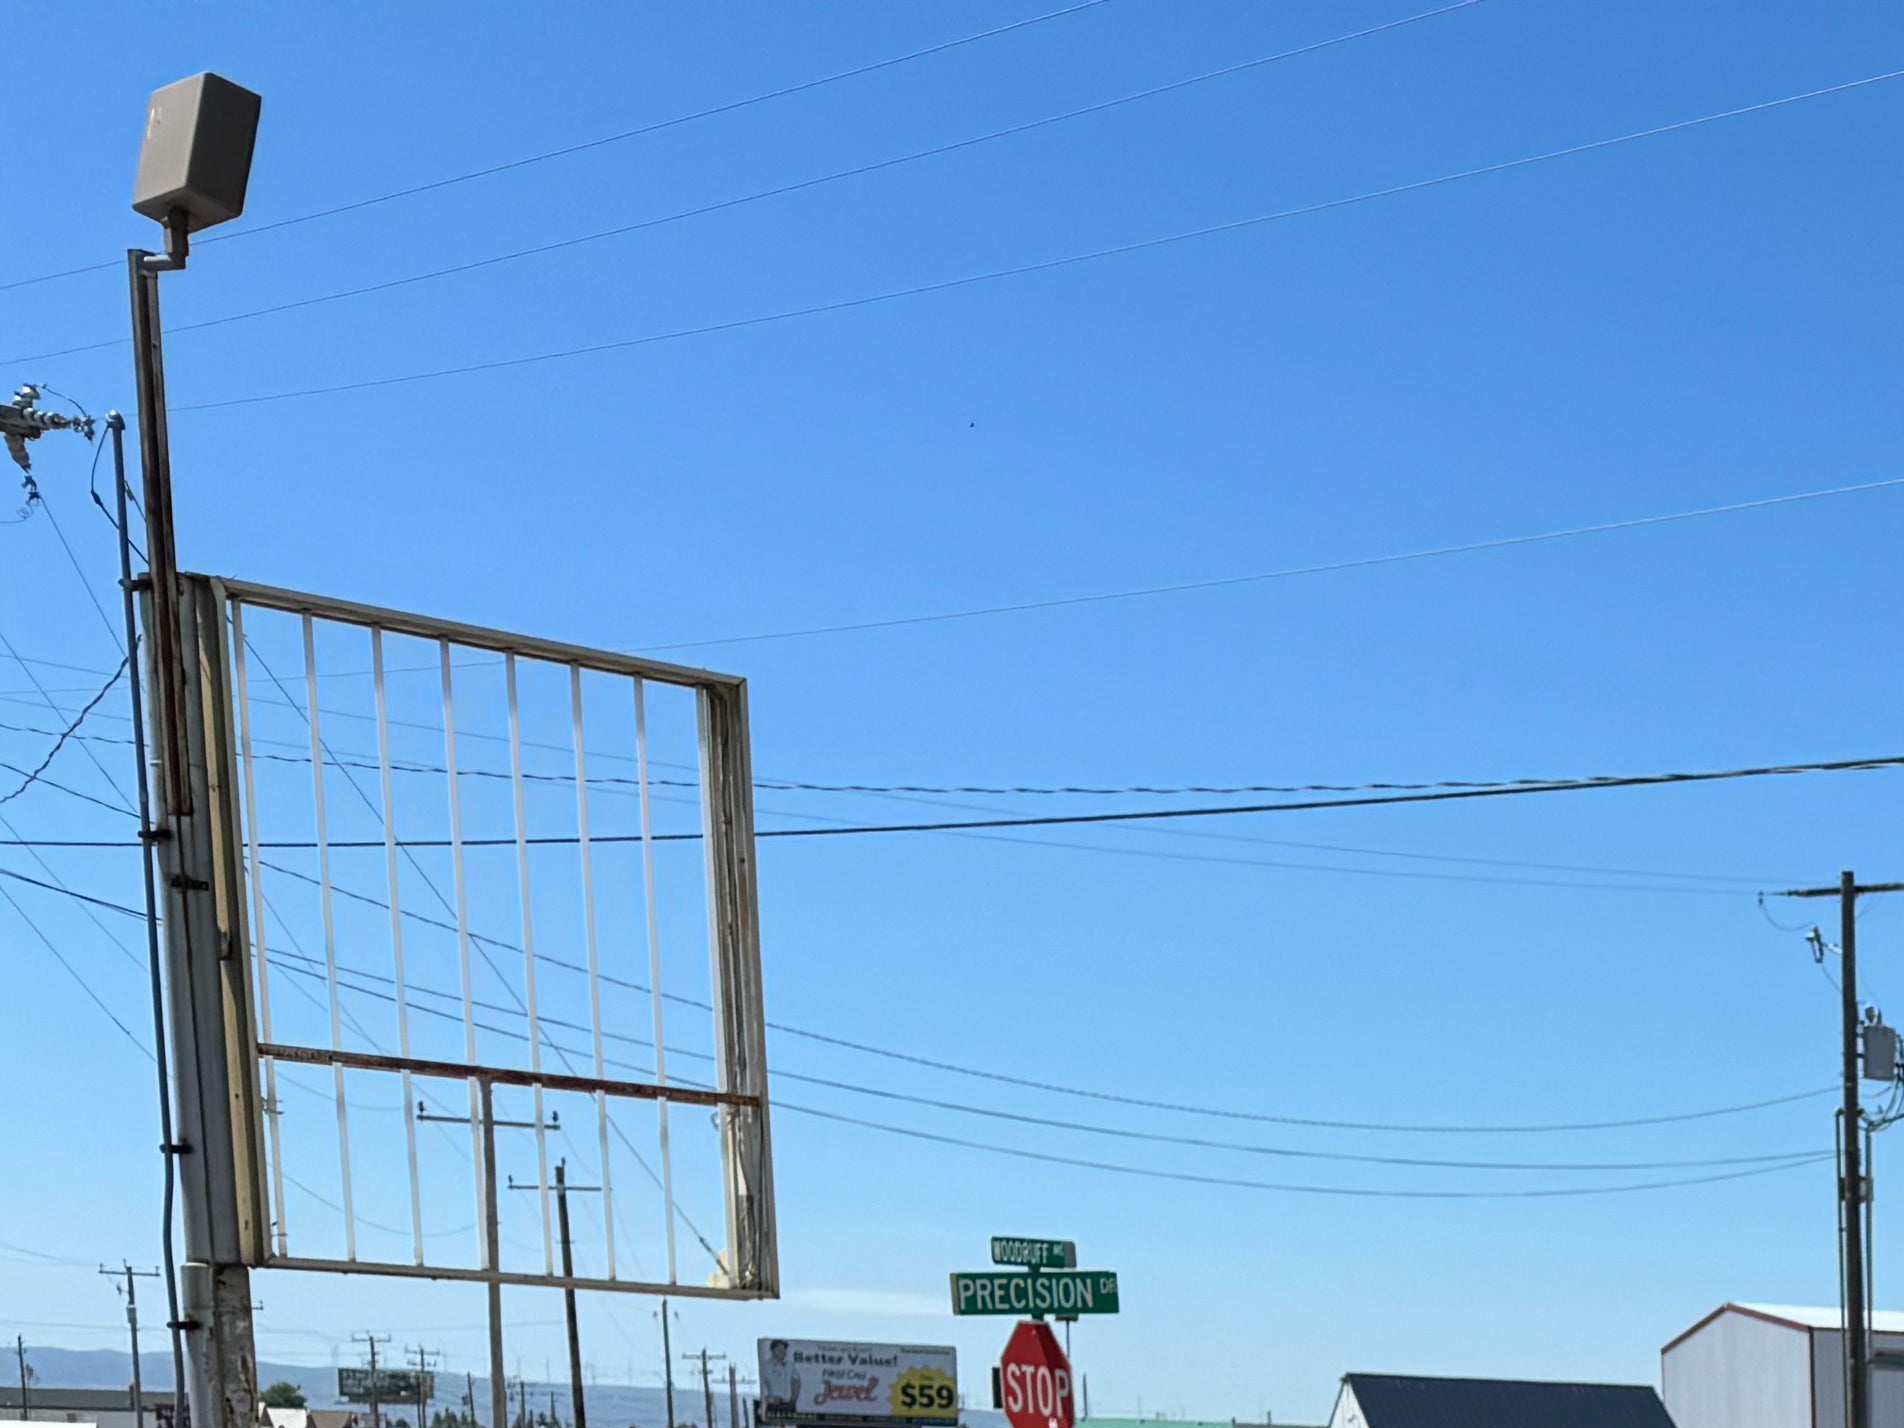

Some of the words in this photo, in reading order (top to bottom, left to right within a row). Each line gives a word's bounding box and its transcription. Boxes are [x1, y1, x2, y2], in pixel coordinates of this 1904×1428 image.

[992, 1238, 1049, 1264] WOODRUFF
[958, 1277, 1094, 1310] PRECISION
[793, 1352, 843, 1364] Better
[847, 1353, 898, 1367] Value!
[900, 1381, 954, 1410] $59
[1007, 1361, 1070, 1418] STOP
